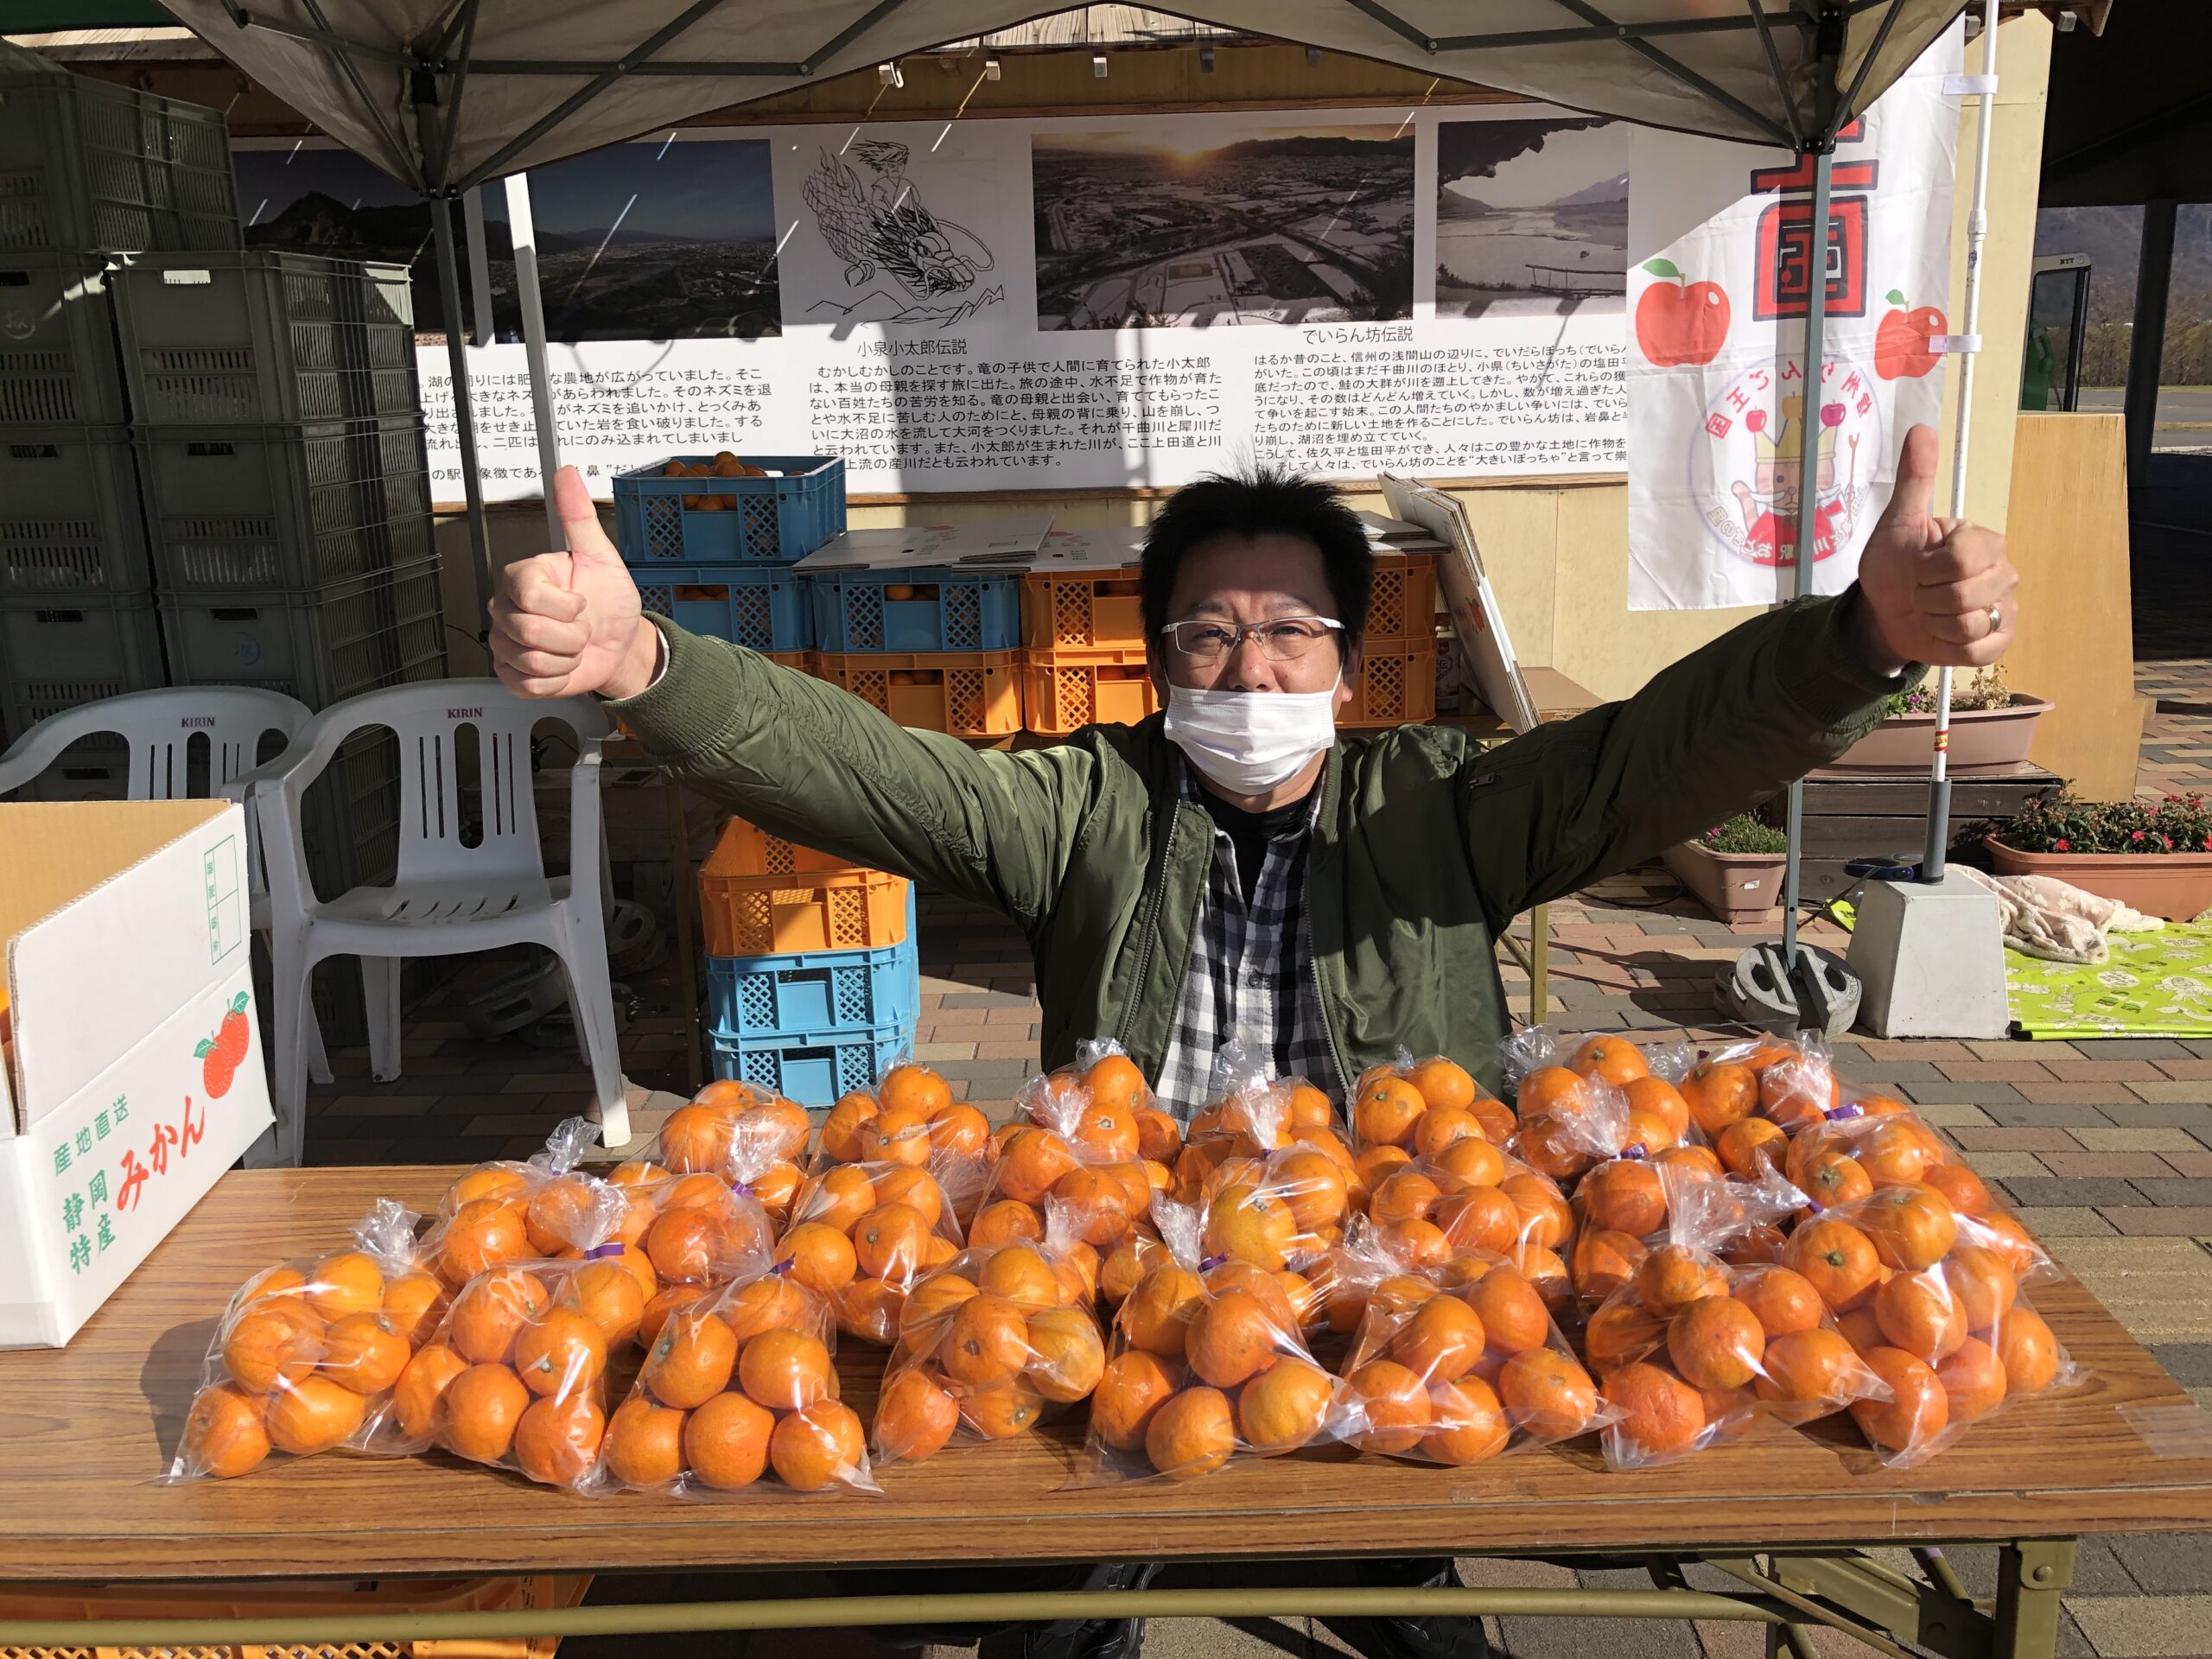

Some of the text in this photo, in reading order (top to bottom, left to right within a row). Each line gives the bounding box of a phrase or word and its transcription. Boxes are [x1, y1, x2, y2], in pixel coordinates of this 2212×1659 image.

[1303, 326, 1414, 344] でいらん坊伝説
[857, 339, 968, 357] 小泉小太郎伝説
[1255, 431, 1427, 446] り崩し、湖沼を埋め立てていく。
[181, 716, 215, 728] KIRIN
[448, 708, 483, 719] KIRIN
[53, 1093, 130, 1177] 産地直送
[117, 1096, 205, 1212] みかん
[62, 1169, 109, 1233] 静岡
[69, 1213, 116, 1275] 特産
